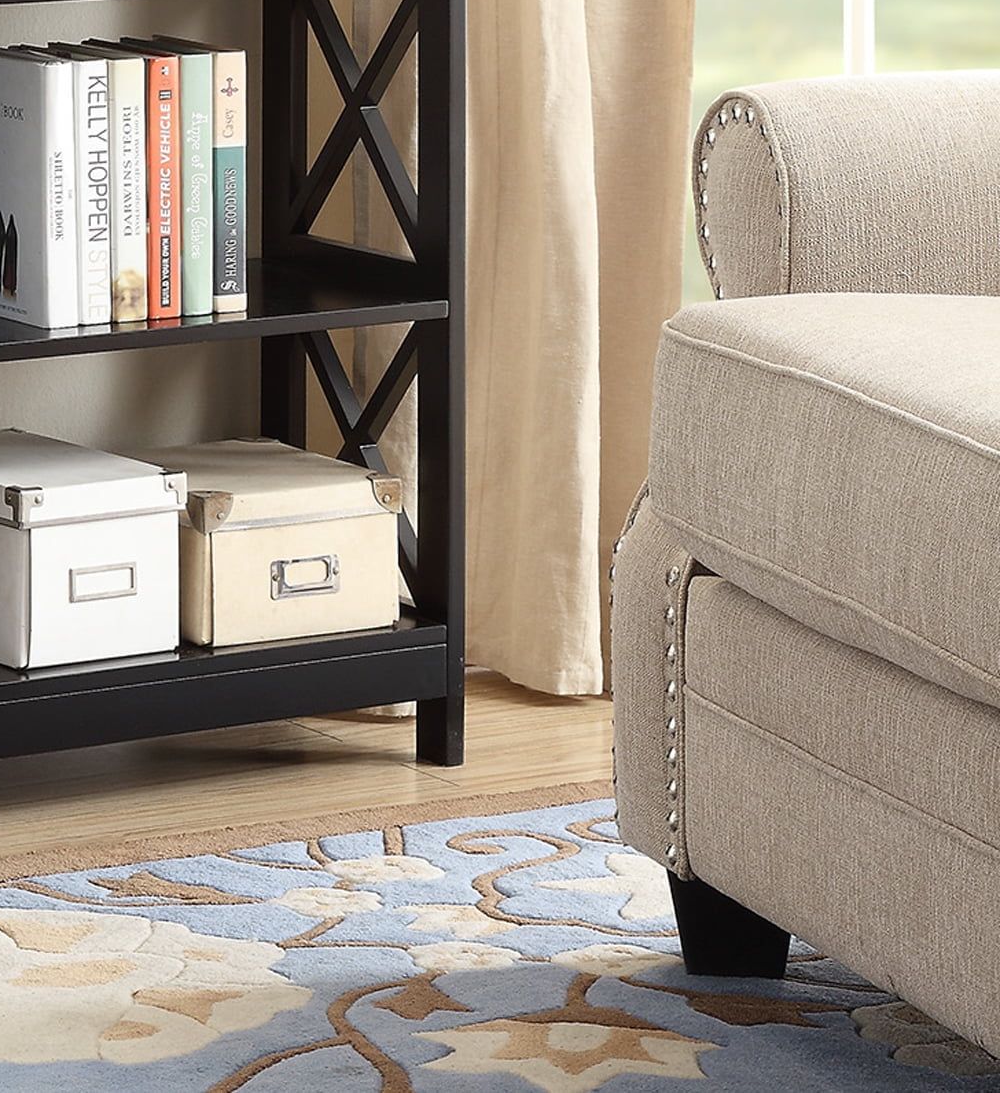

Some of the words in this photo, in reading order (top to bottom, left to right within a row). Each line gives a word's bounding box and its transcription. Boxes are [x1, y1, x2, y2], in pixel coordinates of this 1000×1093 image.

[3, 105, 24, 120] BOOK
[88, 75, 107, 142] KELLY
[223, 108, 237, 139] Casey
[122, 106, 132, 157] TEORI
[160, 104, 170, 164] VEHICLE
[187, 112, 208, 150] Anne
[192, 154, 204, 168] of
[88, 150, 108, 242] HOPPEN
[122, 160, 132, 236] DARWINS
[160, 168, 170, 235] ELECTRIC
[187, 172, 207, 212] Green
[225, 197, 237, 226] GOOD
[54, 210, 64, 242] BOOK
[191, 217, 207, 259] Gables
[162, 238, 170, 257] OWN
[89, 250, 108, 322] STYLE
[162, 258, 170, 280] YOUR
[162, 281, 170, 305] BUILD
